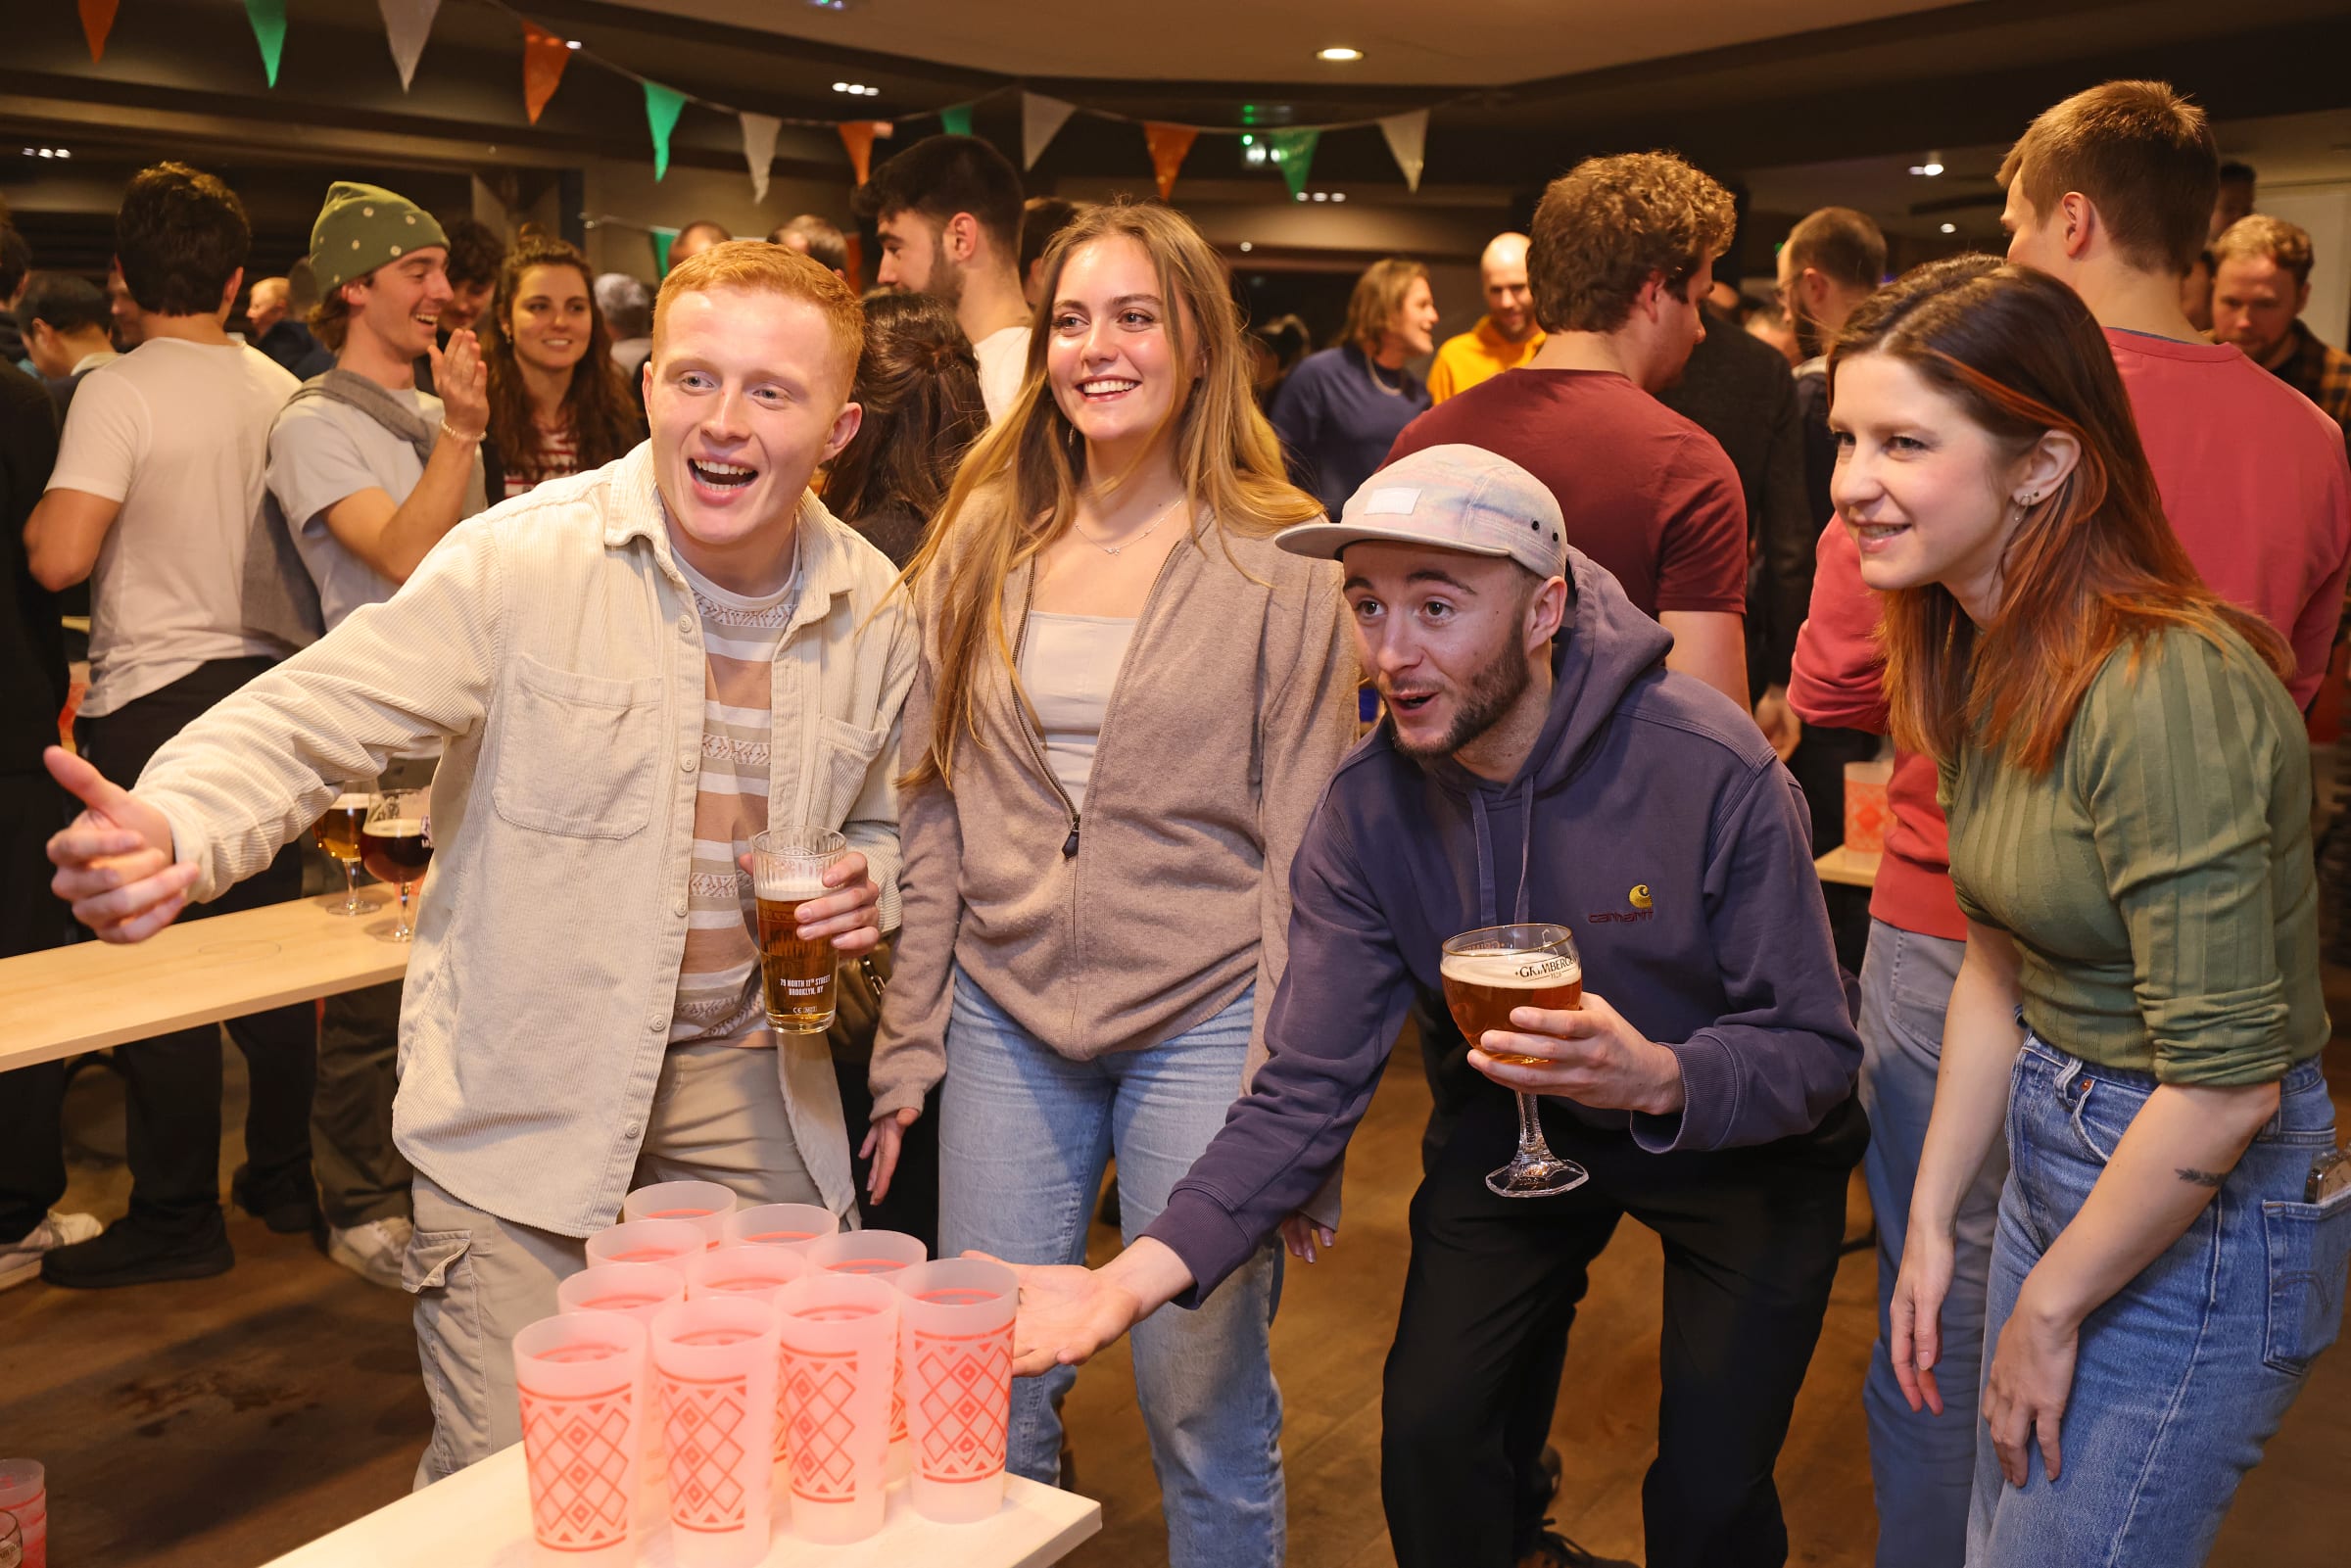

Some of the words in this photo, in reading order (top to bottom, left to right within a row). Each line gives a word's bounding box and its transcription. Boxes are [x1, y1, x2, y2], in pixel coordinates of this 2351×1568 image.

[1519, 954, 1577, 977] GRMBERGN
[815, 974, 831, 985] STREET
[817, 985, 824, 994] NY
